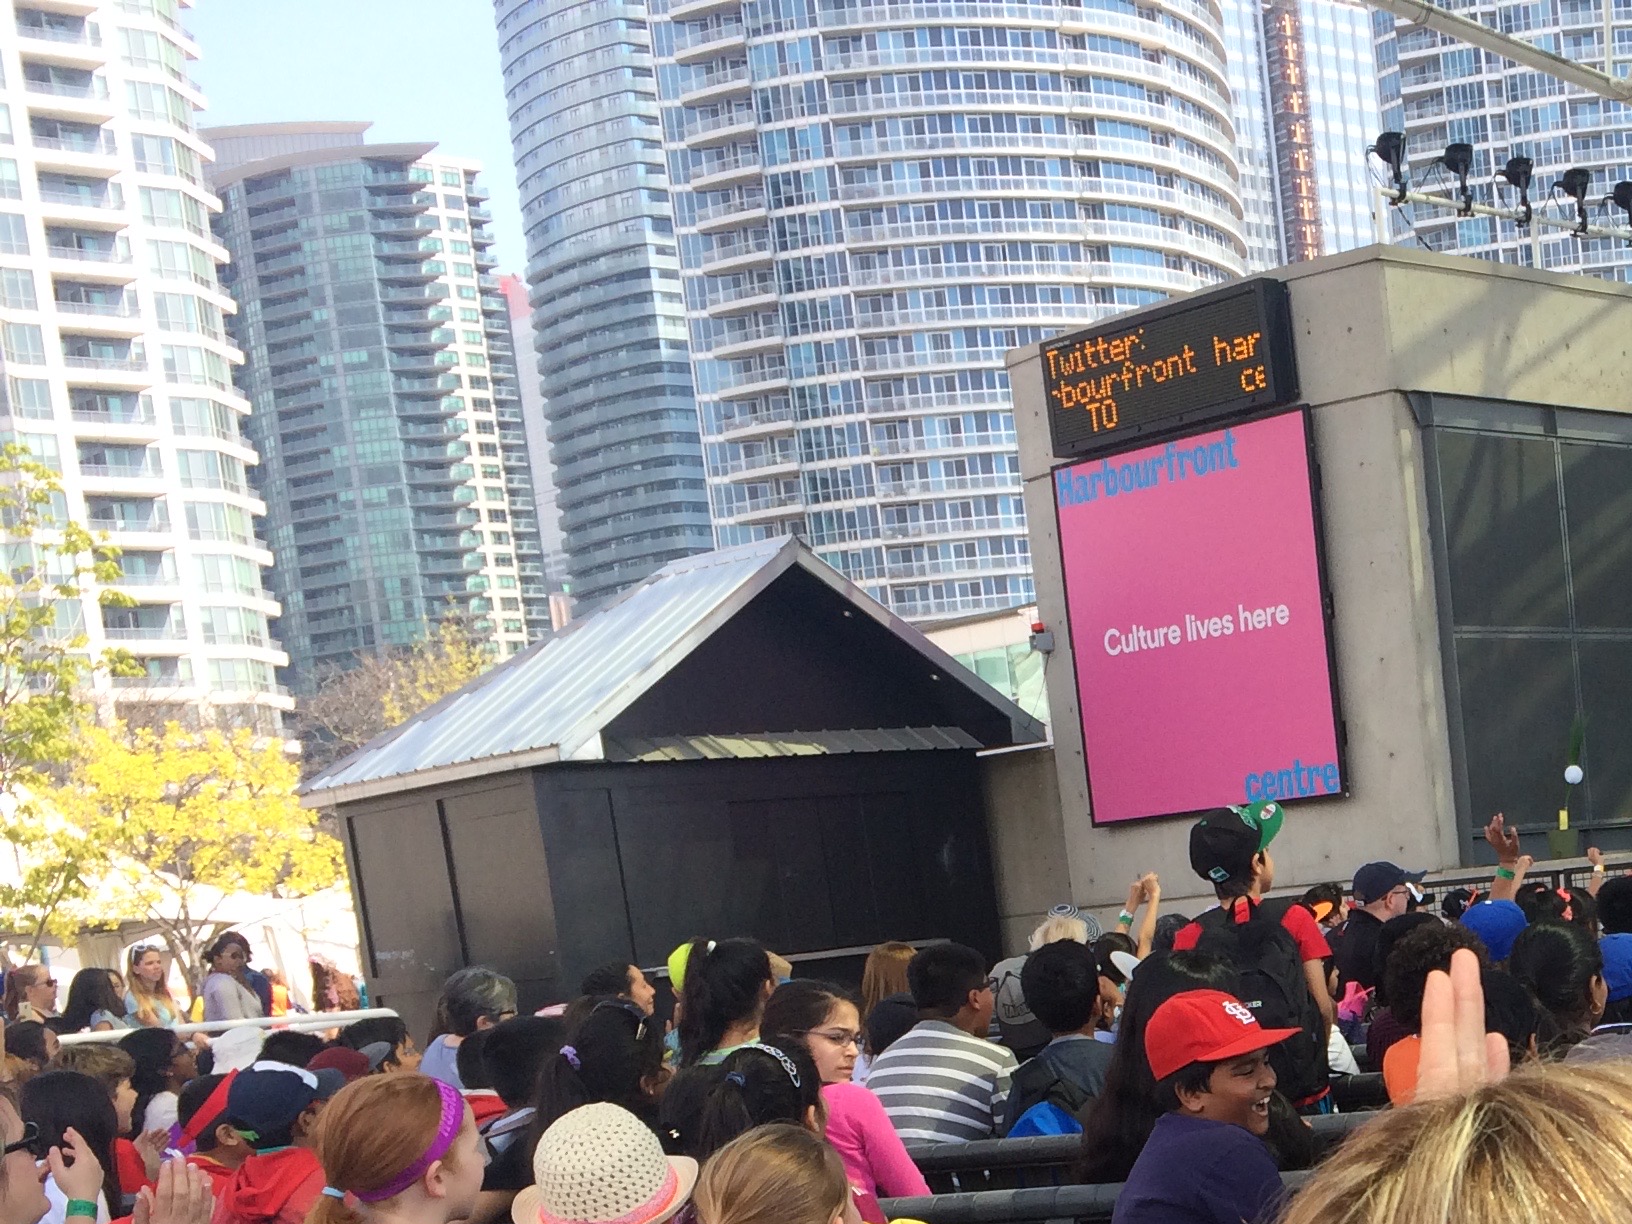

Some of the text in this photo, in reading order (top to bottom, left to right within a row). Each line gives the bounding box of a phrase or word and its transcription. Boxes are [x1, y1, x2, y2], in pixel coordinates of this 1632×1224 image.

[1046, 327, 1146, 379] Twitter:
[1212, 332, 1261, 366] har
[1086, 399, 1119, 433] TO
[1054, 428, 1239, 508] Harbourfront
[1104, 603, 1290, 656] Culture lives here
[1245, 759, 1340, 801] centre
